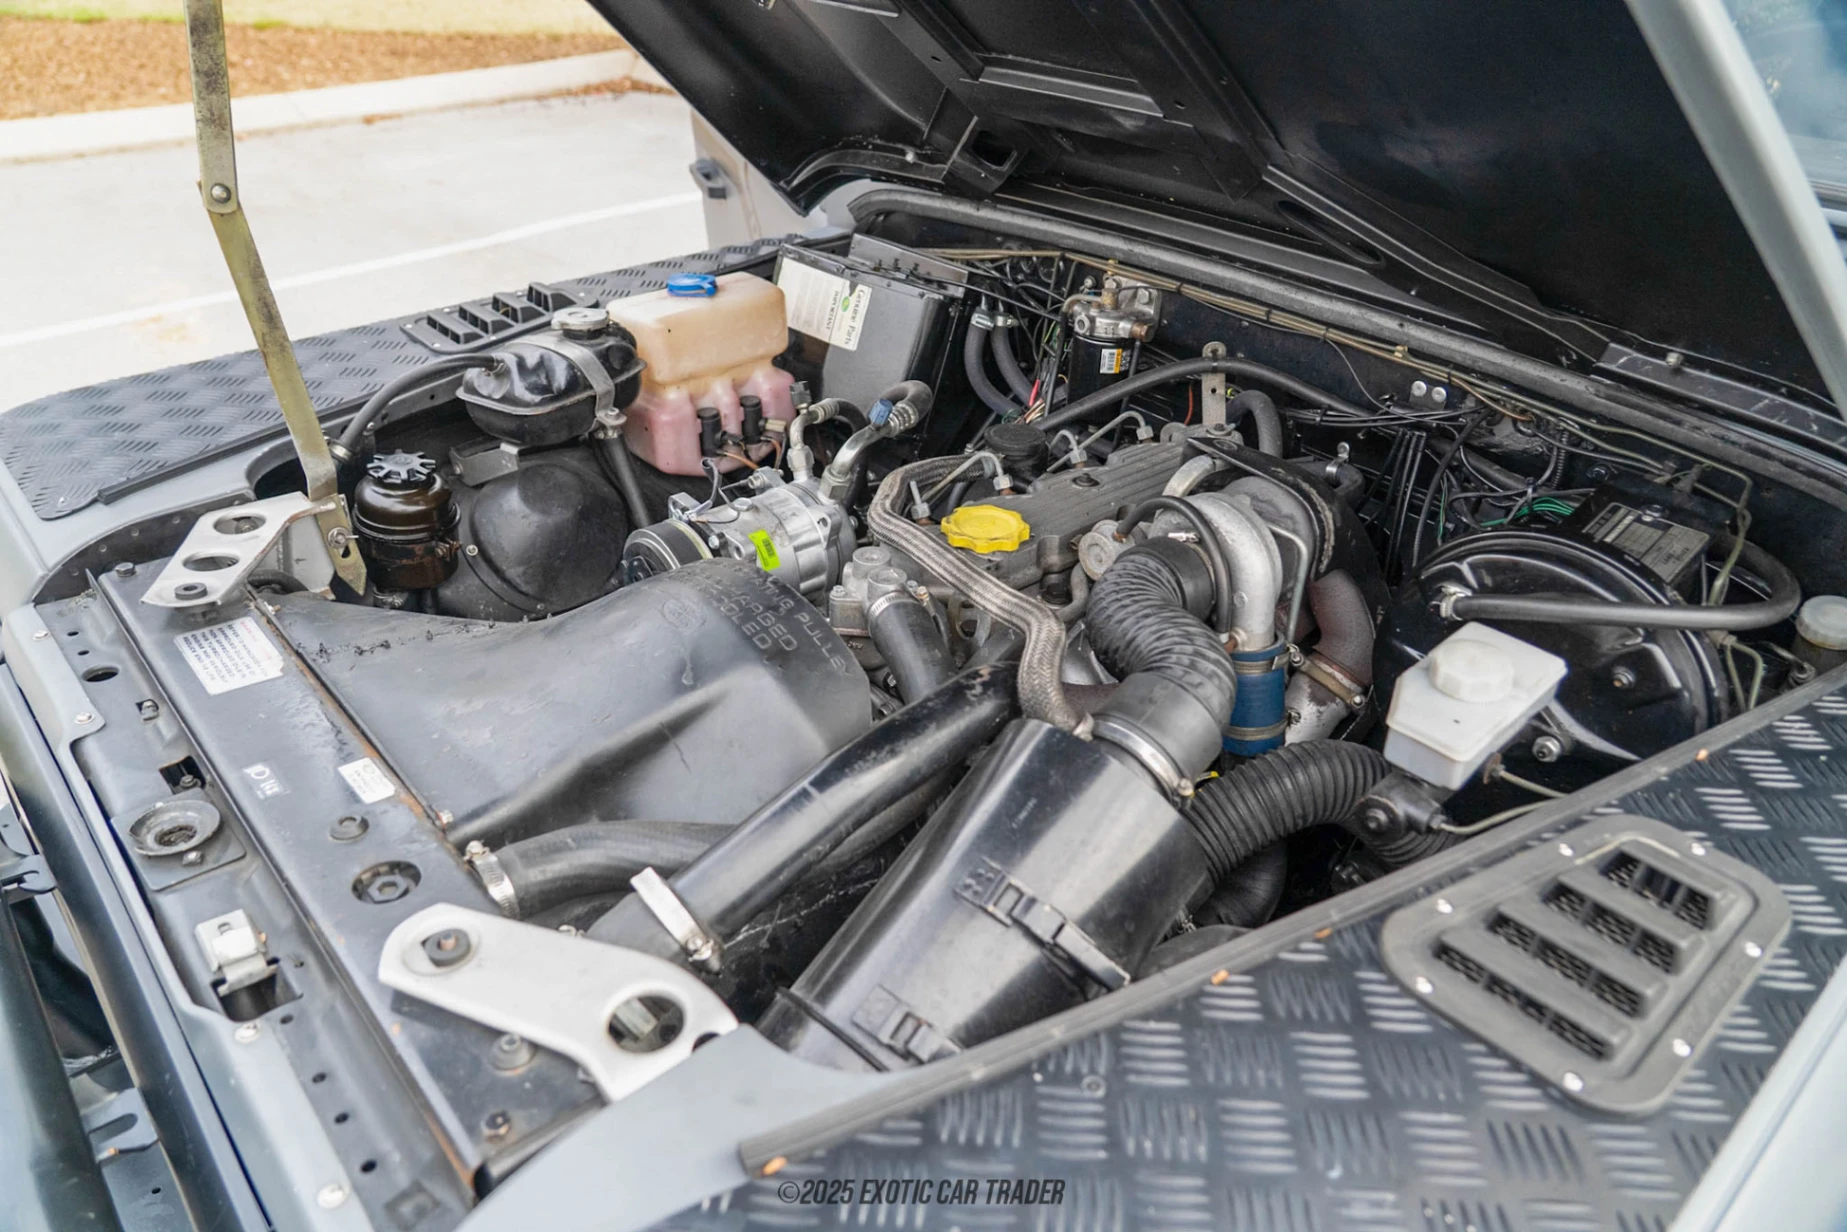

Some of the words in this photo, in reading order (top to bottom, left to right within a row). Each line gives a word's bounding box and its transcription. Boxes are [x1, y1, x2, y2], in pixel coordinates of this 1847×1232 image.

[826, 290, 839, 330] IMPORTANT
[844, 325, 857, 345] Parts
[795, 612, 854, 677] PULLEY
